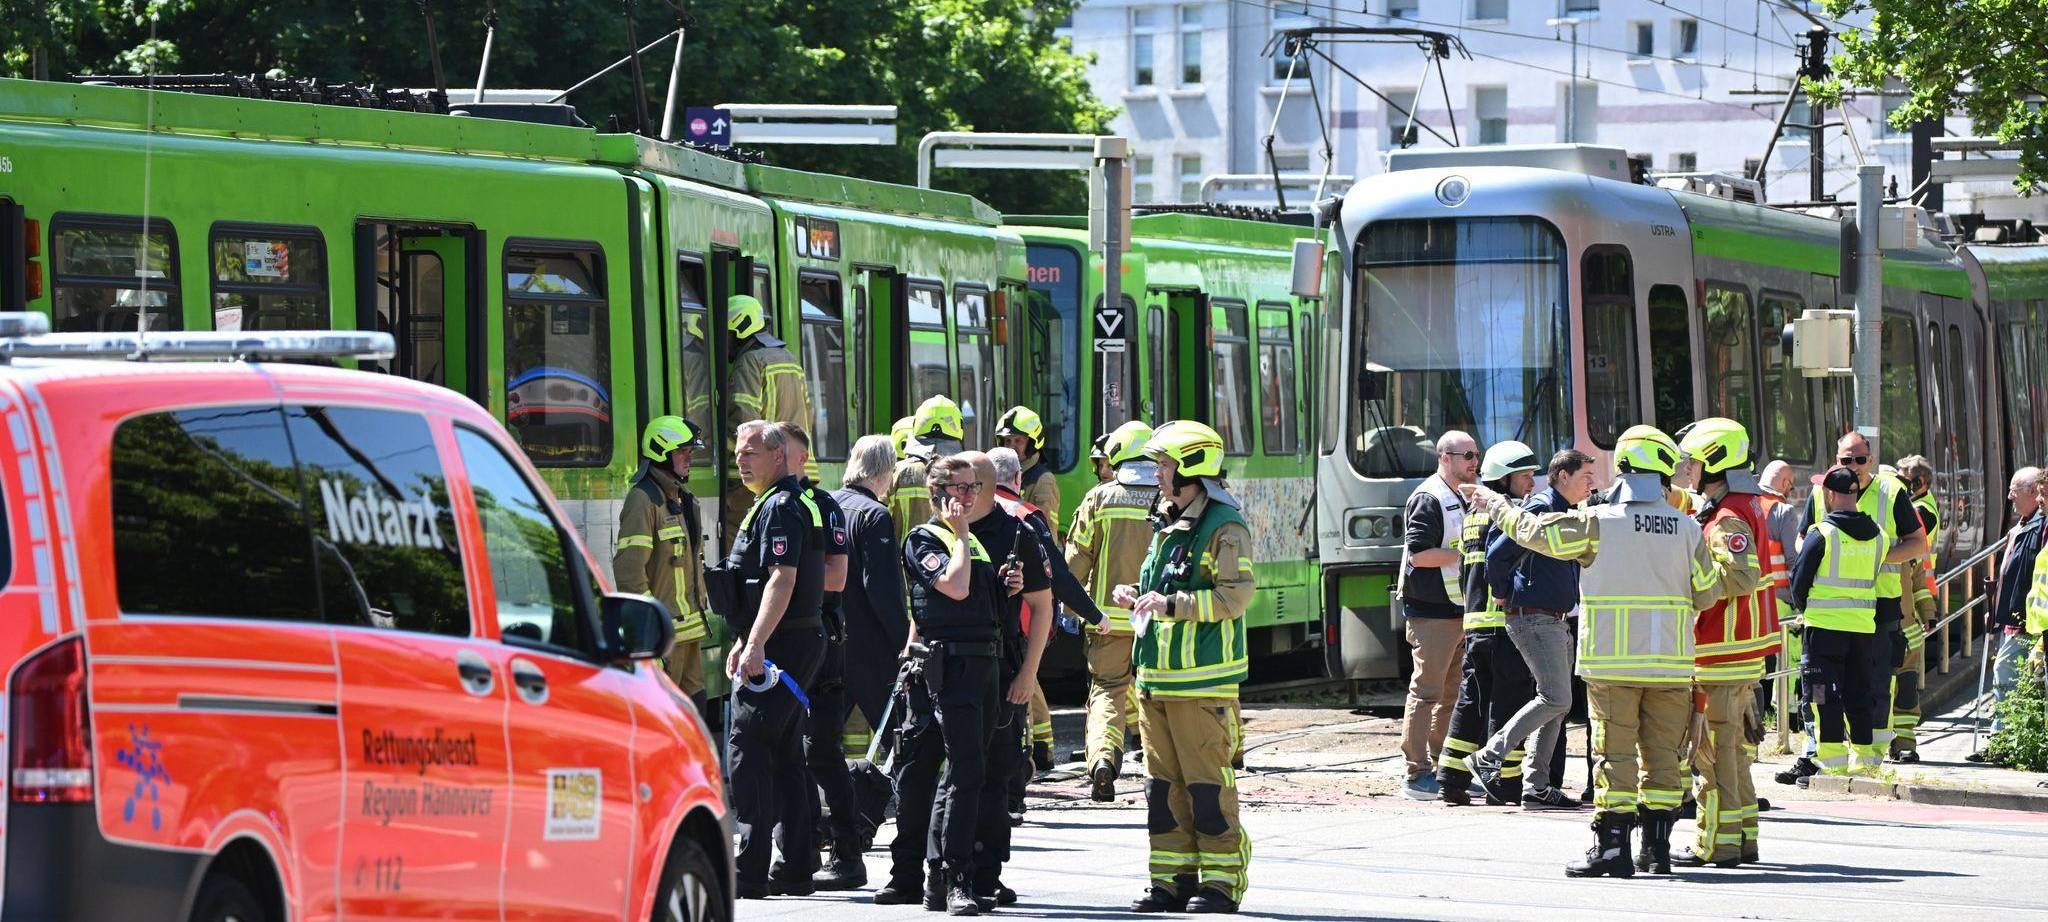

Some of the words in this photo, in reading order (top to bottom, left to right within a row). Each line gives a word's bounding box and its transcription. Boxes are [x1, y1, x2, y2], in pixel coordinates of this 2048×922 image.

[319, 478, 443, 550] Notarzt
[1634, 513, 1679, 535] B-DIENST
[362, 727, 479, 777] Rettungsdienst
[362, 779, 417, 826] Region
[421, 781, 493, 816] Hannover
[374, 856, 403, 892] 112
